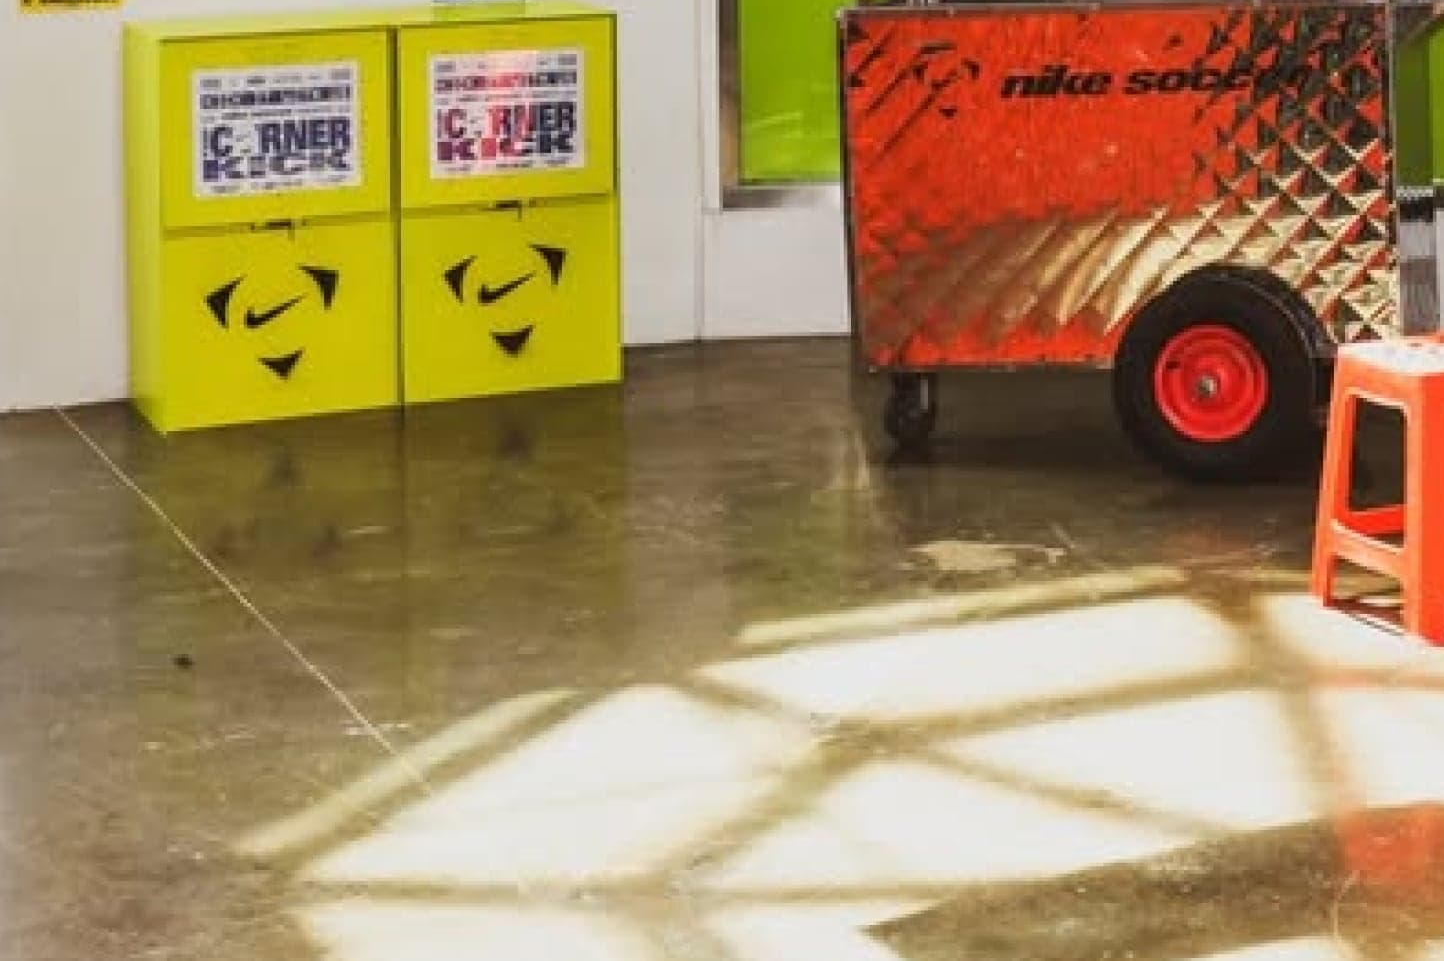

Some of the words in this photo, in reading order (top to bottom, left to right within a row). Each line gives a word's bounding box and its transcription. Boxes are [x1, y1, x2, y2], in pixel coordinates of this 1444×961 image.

[1001, 62, 1113, 98] nike
[209, 116, 351, 157] CRNER
[443, 101, 577, 139] CRNER
